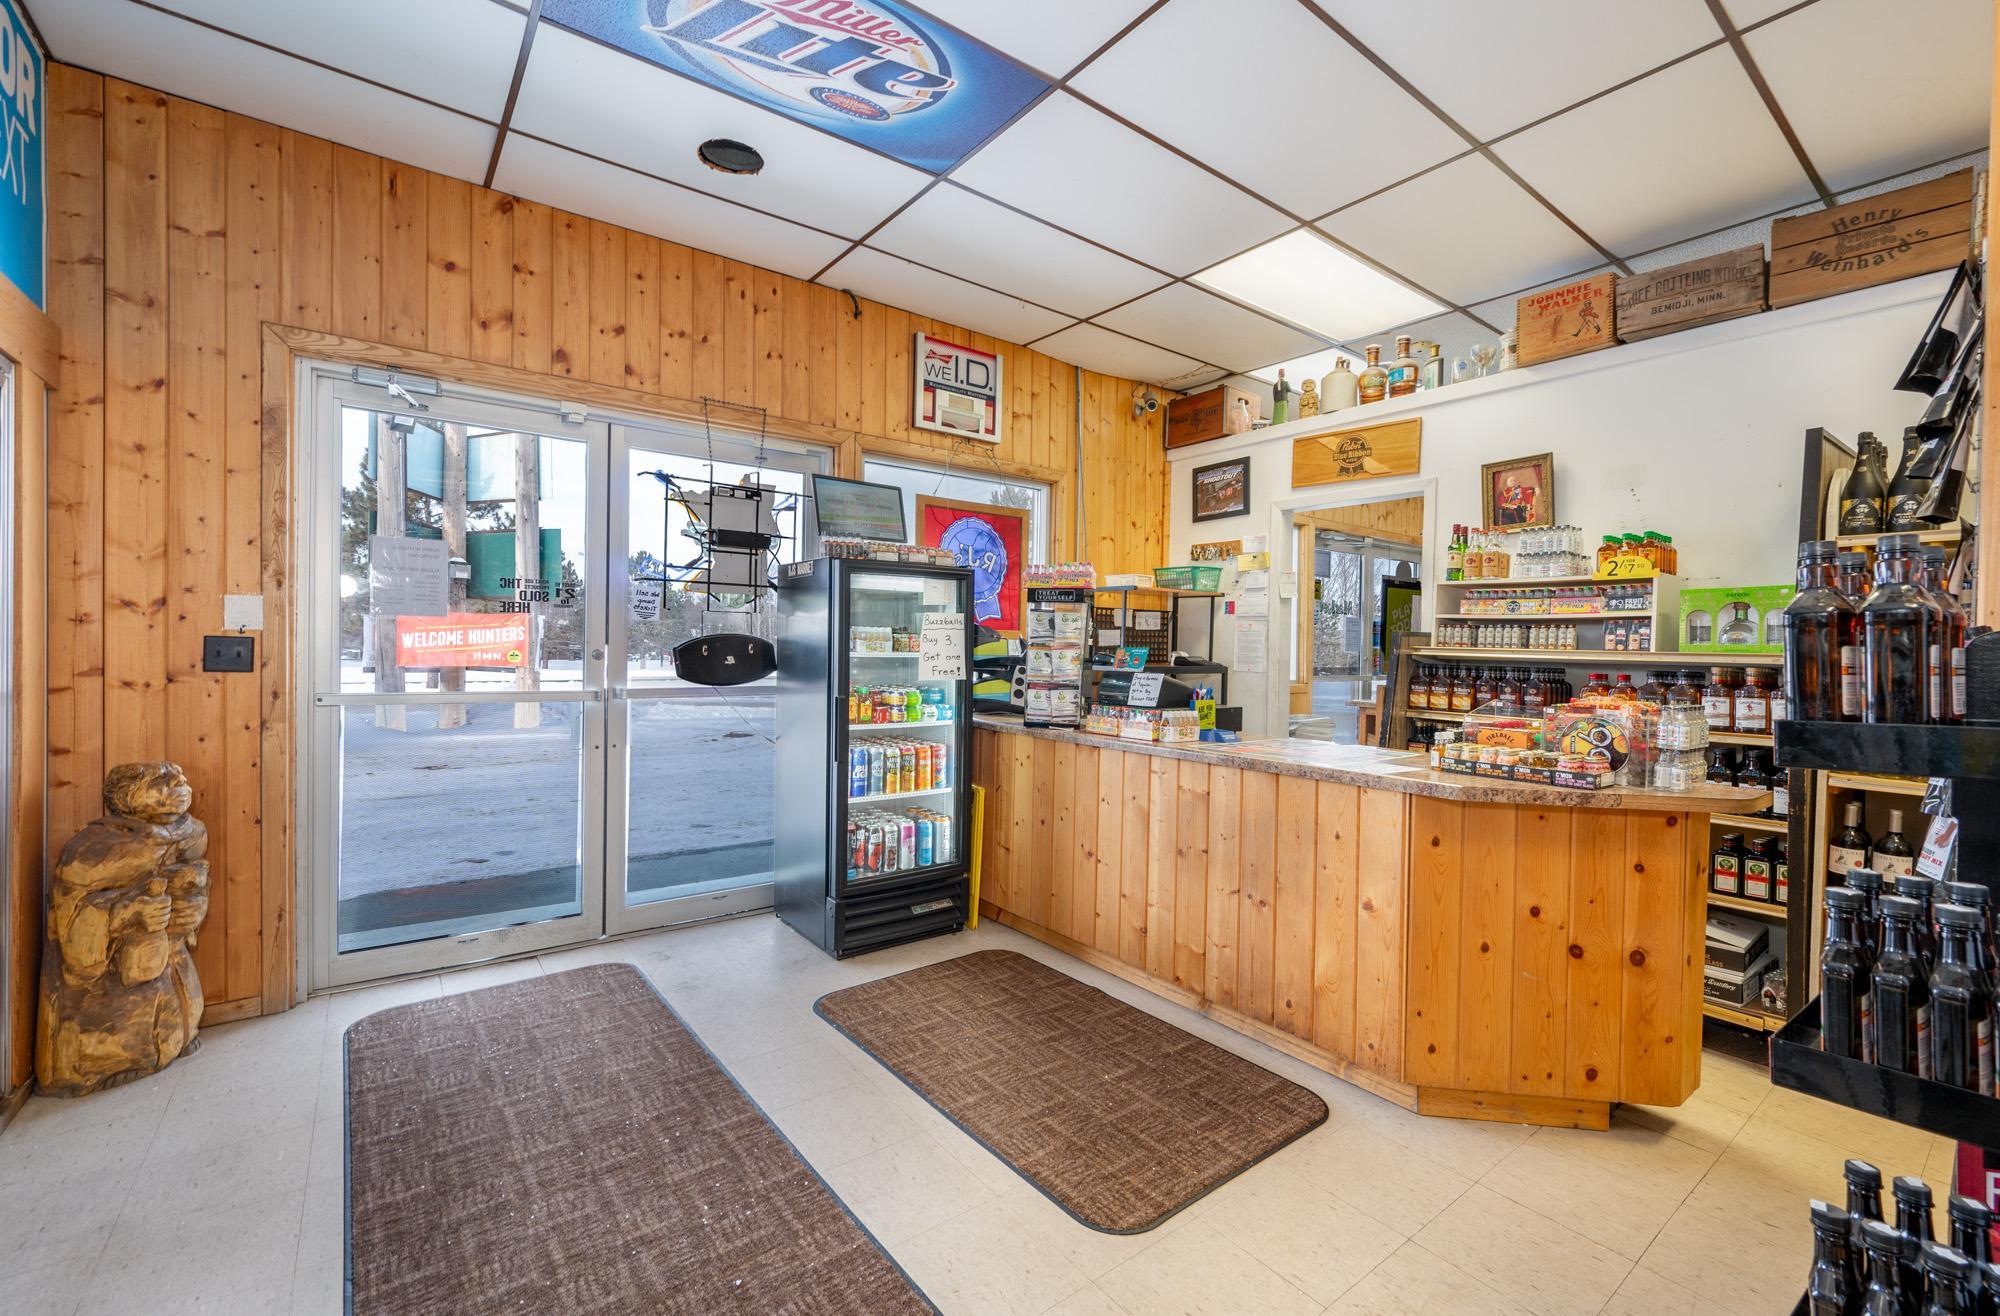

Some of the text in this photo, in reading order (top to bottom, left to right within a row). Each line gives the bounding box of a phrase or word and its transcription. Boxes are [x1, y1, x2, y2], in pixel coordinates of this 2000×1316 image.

[1830, 208, 1903, 234] Henry
[1806, 228, 1929, 272] Weinhard's
[1655, 269, 1711, 296] BOTTLING
[1528, 282, 1591, 307] JOHNNIE
[1538, 288, 1602, 311] WALKER
[1651, 291, 1726, 315] BEMIDJI, MINN.
[925, 355, 993, 391] WE I.D.
[924, 615, 963, 626] Buzzballs
[401, 626, 525, 648] WELCOME HUNTERS
[923, 634, 938, 646] Buy
[923, 652, 940, 662] Get
[932, 666, 961, 677] Free!
